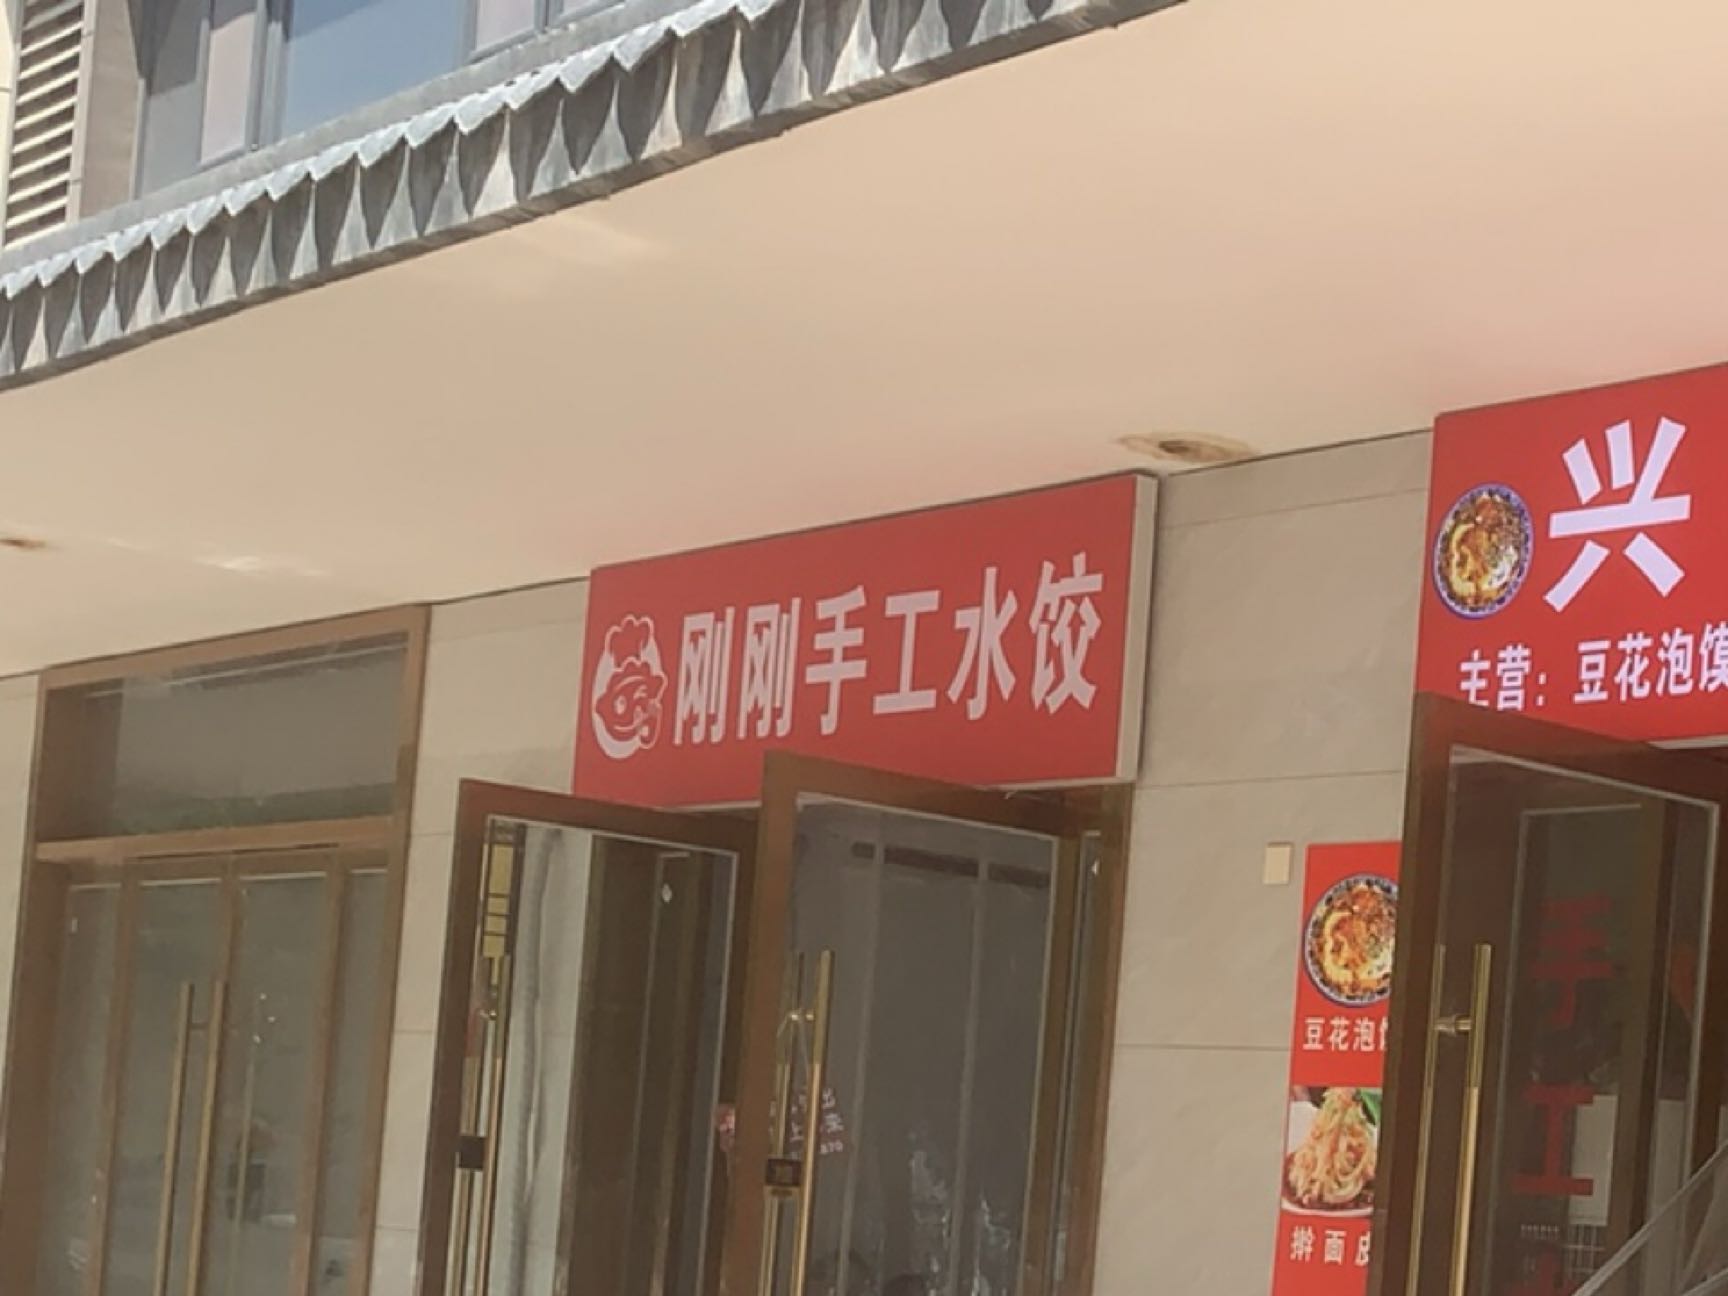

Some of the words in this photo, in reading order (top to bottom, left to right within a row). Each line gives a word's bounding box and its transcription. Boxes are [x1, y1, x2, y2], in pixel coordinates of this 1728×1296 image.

[674, 552, 1103, 746] 刚刚手工水饺
